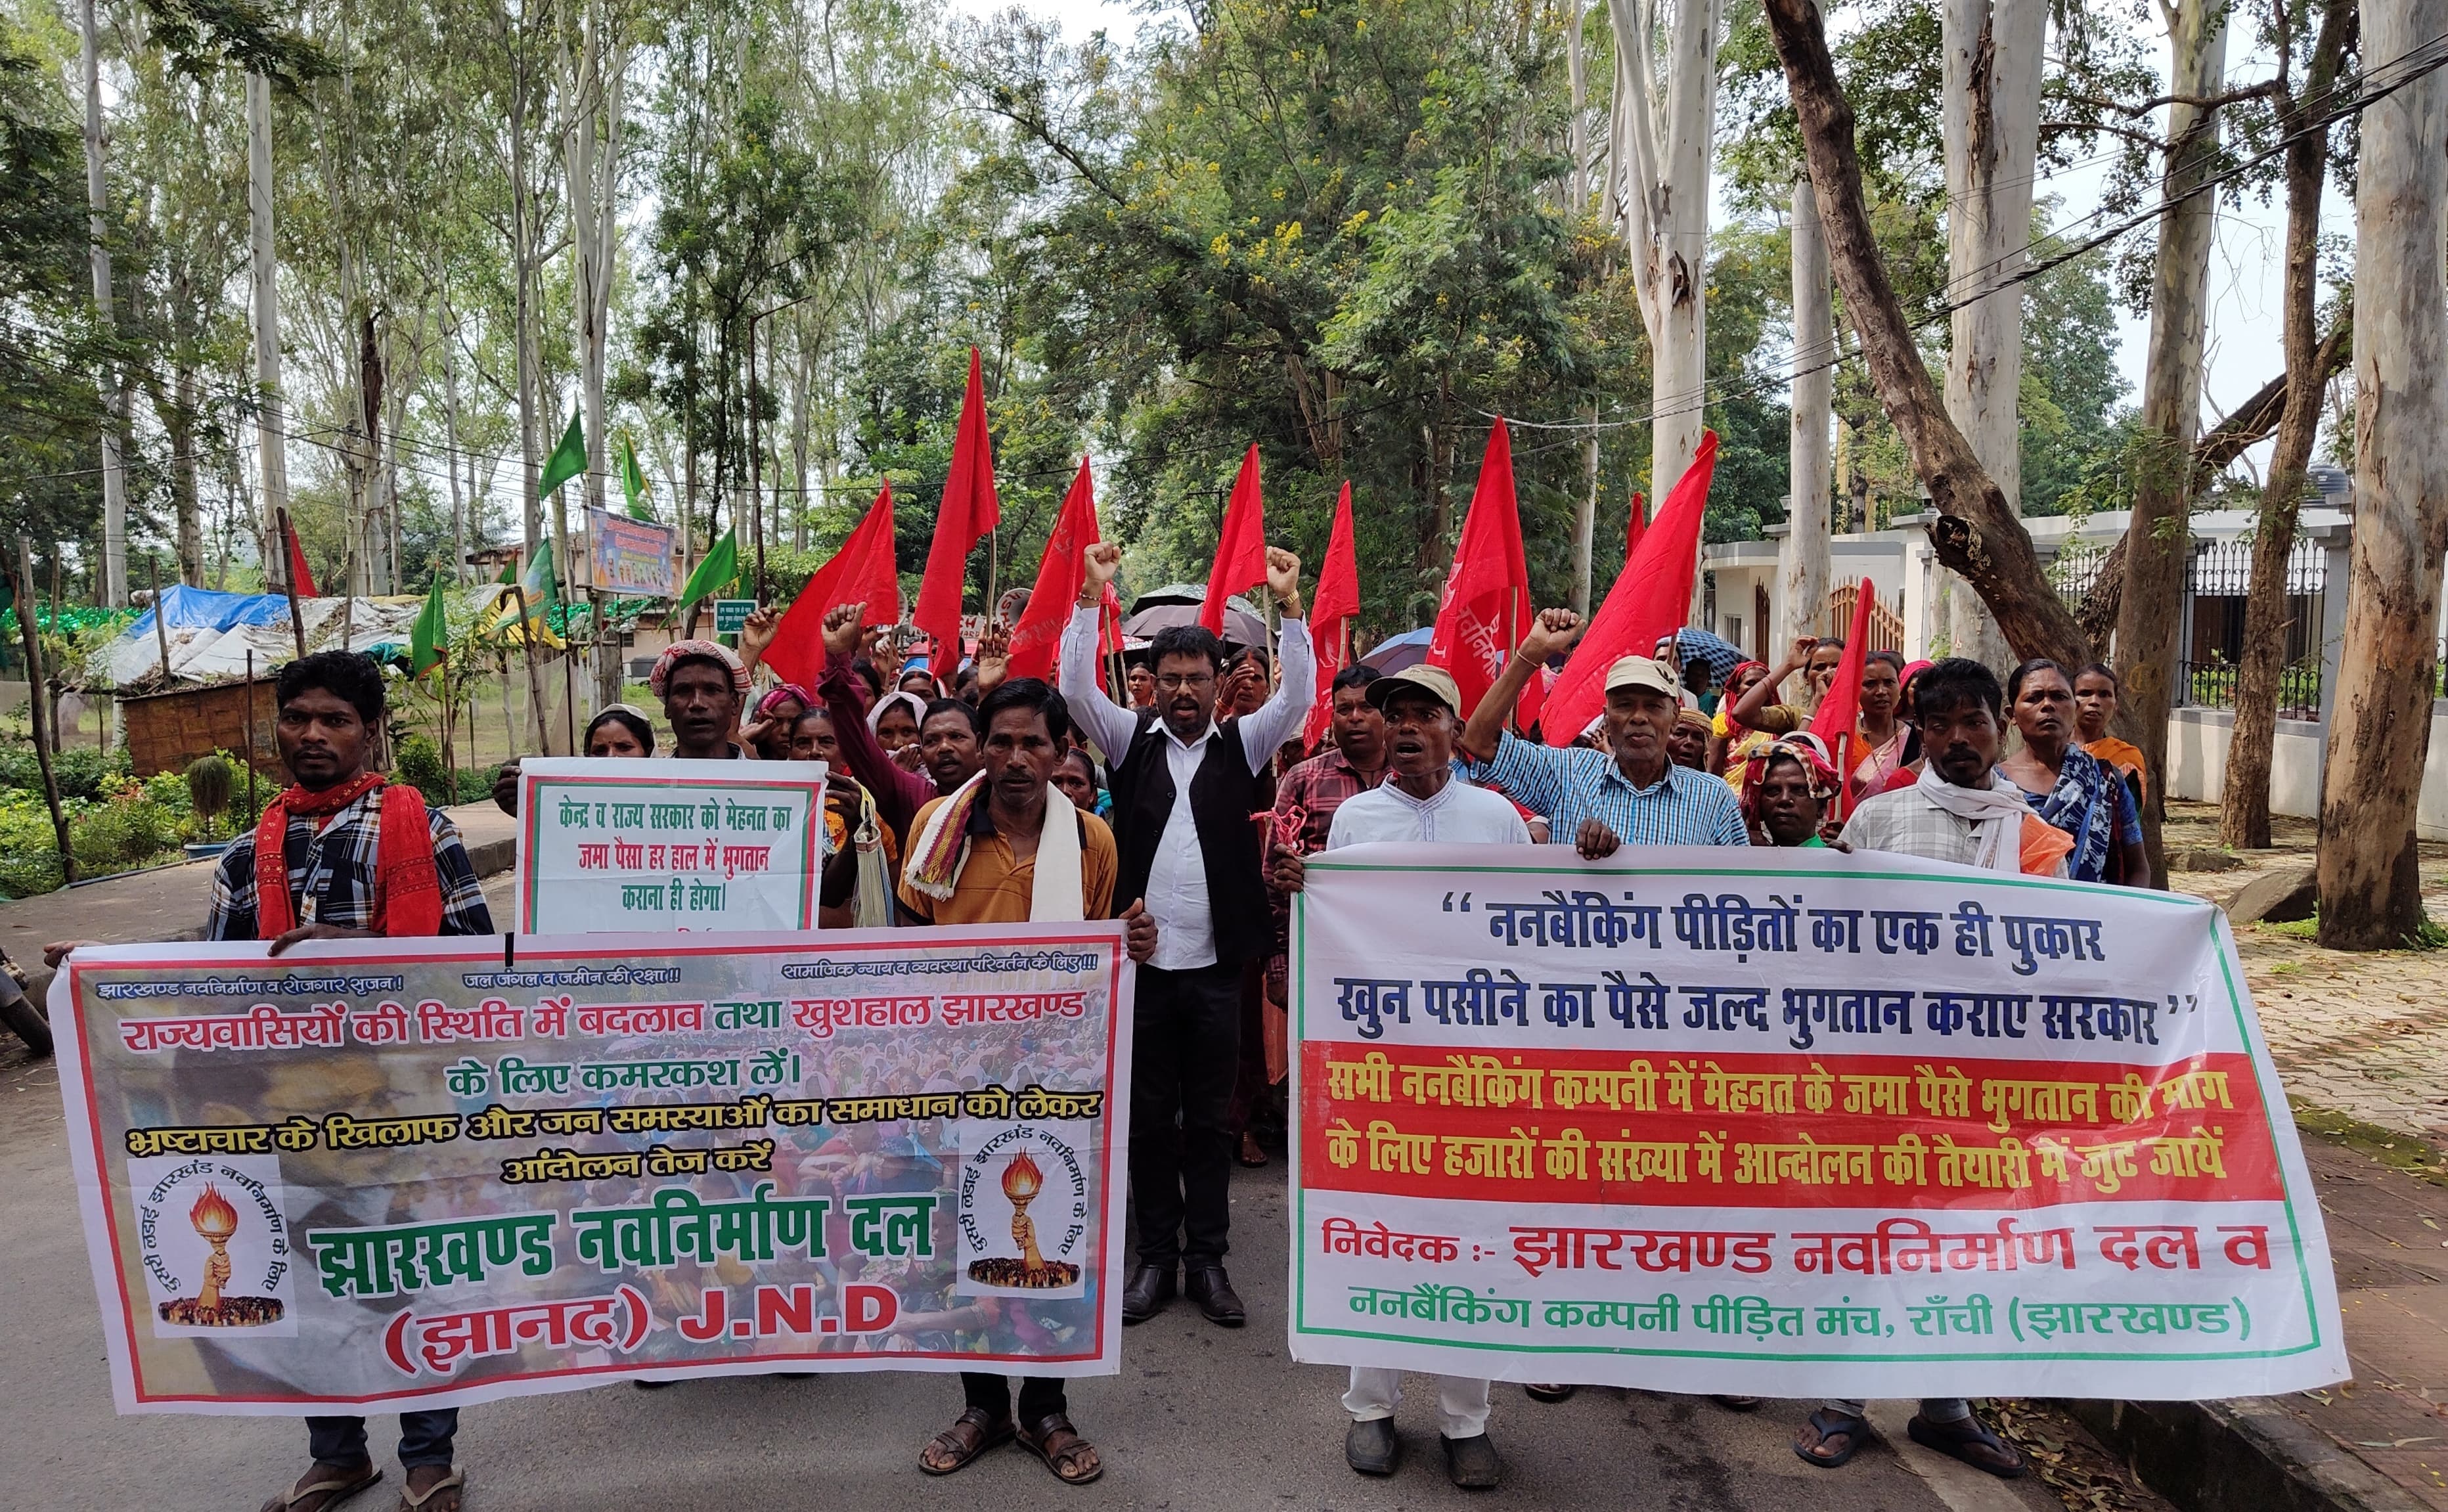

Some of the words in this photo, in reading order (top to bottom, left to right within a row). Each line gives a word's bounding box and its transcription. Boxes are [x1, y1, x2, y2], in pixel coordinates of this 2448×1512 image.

[559, 795, 589, 830] केन्द्र
[595, 803, 606, 824] व
[612, 803, 645, 830] राज्य
[650, 804, 695, 830] सरकार
[700, 797, 720, 830] को
[726, 798, 767, 831] मेहनत
[772, 807, 792, 831] का
[578, 844, 610, 869] जमा
[615, 836, 643, 870] पैसा
[649, 845, 666, 870] हर
[671, 845, 699, 870] हाल
[704, 838, 719, 870] में
[723, 846, 770, 880] भुगतान
[621, 885, 664, 910] कराना
[669, 878, 684, 911] ही
[1486, 890, 1662, 949] ननबैंकिंग
[1670, 893, 1802, 963] पीड़ितों
[1808, 909, 1860, 953] का
[1870, 911, 1940, 954] एक
[1949, 901, 1993, 957] ही
[2001, 916, 2106, 975] पुकार
[98, 983, 179, 998] झारखण्ड
[185, 977, 261, 996] नवनिर्माण
[267, 981, 279, 993] व
[285, 975, 344, 994] रोजगार
[464, 974, 493, 987] जल
[497, 970, 539, 986] जंगल
[542, 973, 556, 985] व
[558, 967, 604, 985] जमीन
[607, 966, 627, 984] की
[784, 960, 853, 978] सामाजिक
[857, 962, 894, 975] न्याय
[897, 962, 908, 974] व
[912, 958, 969, 973] व्यवस्था
[971, 954, 1029, 973] परिवर्तन
[1031, 954, 1049, 970] के
[121, 1004, 345, 1051] राज्यवासियों
[353, 1003, 408, 1044] की
[418, 1000, 523, 1041] स्थिति
[534, 999, 571, 1036] में
[578, 1004, 703, 1034] बदलाव
[713, 1002, 782, 1030] तथा
[791, 996, 934, 1038] खुशहाल
[941, 992, 1086, 1025] झारखण्ड
[1334, 978, 1412, 1039] खुन
[1421, 969, 1530, 1026] पसीने
[1540, 983, 1596, 1028] का
[1602, 971, 1670, 1030] पैसे
[1678, 987, 1770, 1032] जल्द
[1783, 987, 1915, 1050] भुगतान
[1923, 992, 2033, 1037] कराए
[447, 1060, 488, 1095] के
[499, 1058, 570, 1094] लिए
[581, 1059, 738, 1090] कमरकश
[1326, 1052, 1394, 1101] सभी
[1400, 1055, 1545, 1109] ननबैंकिंग
[1550, 1059, 1660, 1111] कम्पनी
[1664, 1060, 1697, 1112] में
[1701, 1061, 1796, 1114] मेहनत
[1801, 1063, 1835, 1114] के
[1839, 1075, 1909, 1115] जमा
[1913, 1064, 1973, 1117] पैसे
[1982, 1078, 2100, 1134] भुगतान
[2106, 1073, 2154, 1124] की
[2158, 1061, 2233, 1111] मांग
[131, 1129, 265, 1155] भ्रष्टाचार
[277, 1119, 315, 1149] के
[327, 1116, 459, 1148] खिलाफ
[470, 1109, 535, 1138] और
[541, 1113, 600, 1134] जन
[610, 1096, 766, 1130] समस्याओं
[778, 1101, 820, 1123] का
[830, 1097, 957, 1121] समाधान
[966, 1087, 1012, 1117] को
[1018, 1087, 1102, 1115] लेकर
[504, 1151, 640, 1182] आंदोलन
[652, 1147, 708, 1174] तेज
[717, 1144, 771, 1173] करें
[973, 1124, 1035, 1165] झारखंड
[1039, 1130, 1086, 1197] नवनिर्माण
[1325, 1119, 1361, 1168] के
[1367, 1121, 1436, 1174] लिए
[1441, 1126, 1540, 1179] हजारों
[1543, 1128, 1591, 1180] की
[1596, 1129, 1688, 1182] संख्या
[1694, 1131, 1727, 1182] में
[1735, 1133, 1873, 1184] आन्दोलन
[1879, 1133, 1929, 1185] की
[1933, 1134, 2032, 1188] तैयारी
[2035, 1136, 2070, 1180] में
[2075, 1140, 2137, 1194] जुट
[2148, 1126, 2227, 1178] जायें
[148, 1159, 214, 1203] झारखंड
[221, 1165, 283, 1234] नवनिर्माण
[1073, 1202, 1087, 1219] के
[272, 1238, 290, 1256] के
[310, 1215, 555, 1297] झारखण्ड
[573, 1186, 828, 1270] नवनिर्माण
[844, 1197, 937, 1256] दल
[1057, 1224, 1083, 1255] लिए
[1322, 1218, 1460, 1262] निवेदक
[1509, 1226, 1776, 1277] झारखण्ड
[1791, 1217, 2076, 1276] नवनिर्माण
[2093, 1225, 2198, 1271] दल
[2217, 1225, 2272, 1270] व
[261, 1261, 288, 1292] लिए
[386, 1289, 650, 1375] (झानद)
[680, 1285, 901, 1339] J.N.D
[1348, 1283, 1531, 1328] ननबैंकिंग
[1542, 1293, 1681, 1333] कम्पनी
[1693, 1293, 1804, 1341] पीड़ित
[1814, 1297, 1895, 1338] मंच,
[1905, 1293, 1993, 1336] राँची
[2009, 1296, 2251, 1341] (झारखण्ड)
